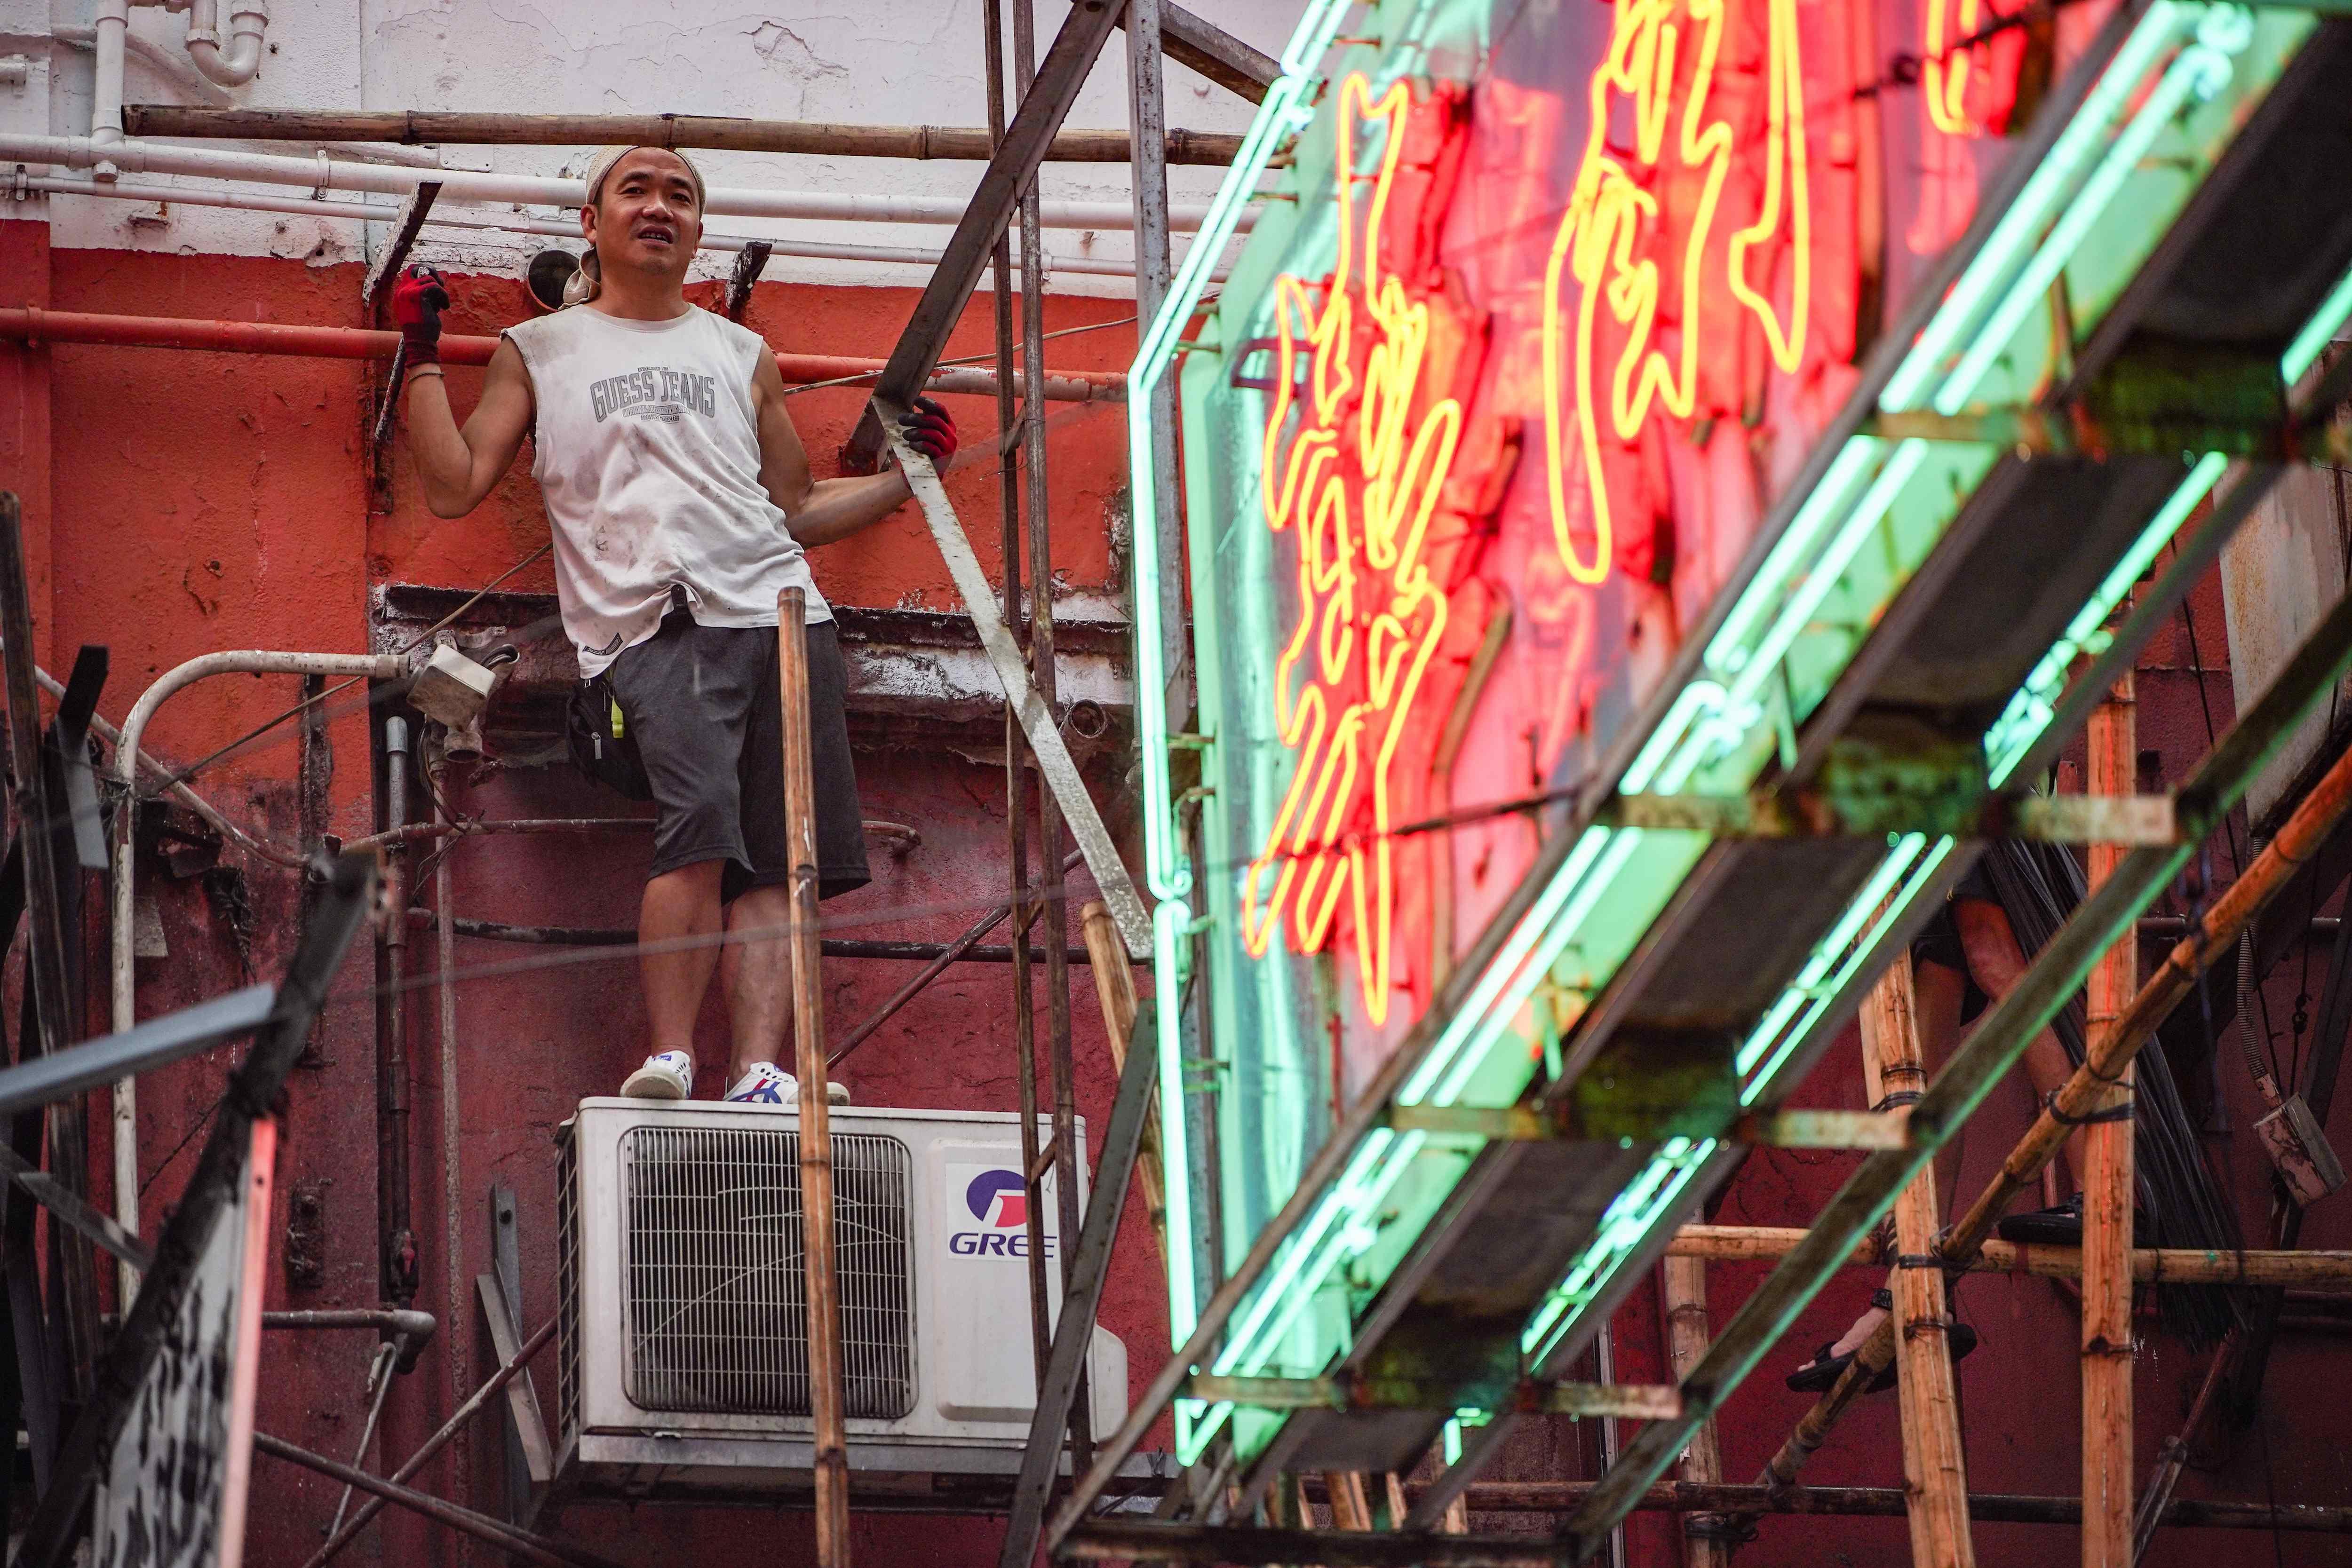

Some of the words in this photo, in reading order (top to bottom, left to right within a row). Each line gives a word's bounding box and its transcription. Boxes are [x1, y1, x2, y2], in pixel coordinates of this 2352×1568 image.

[590, 371, 655, 423] GUESS
[660, 371, 715, 419] JEANS
[949, 1232, 1057, 1258] GREE
